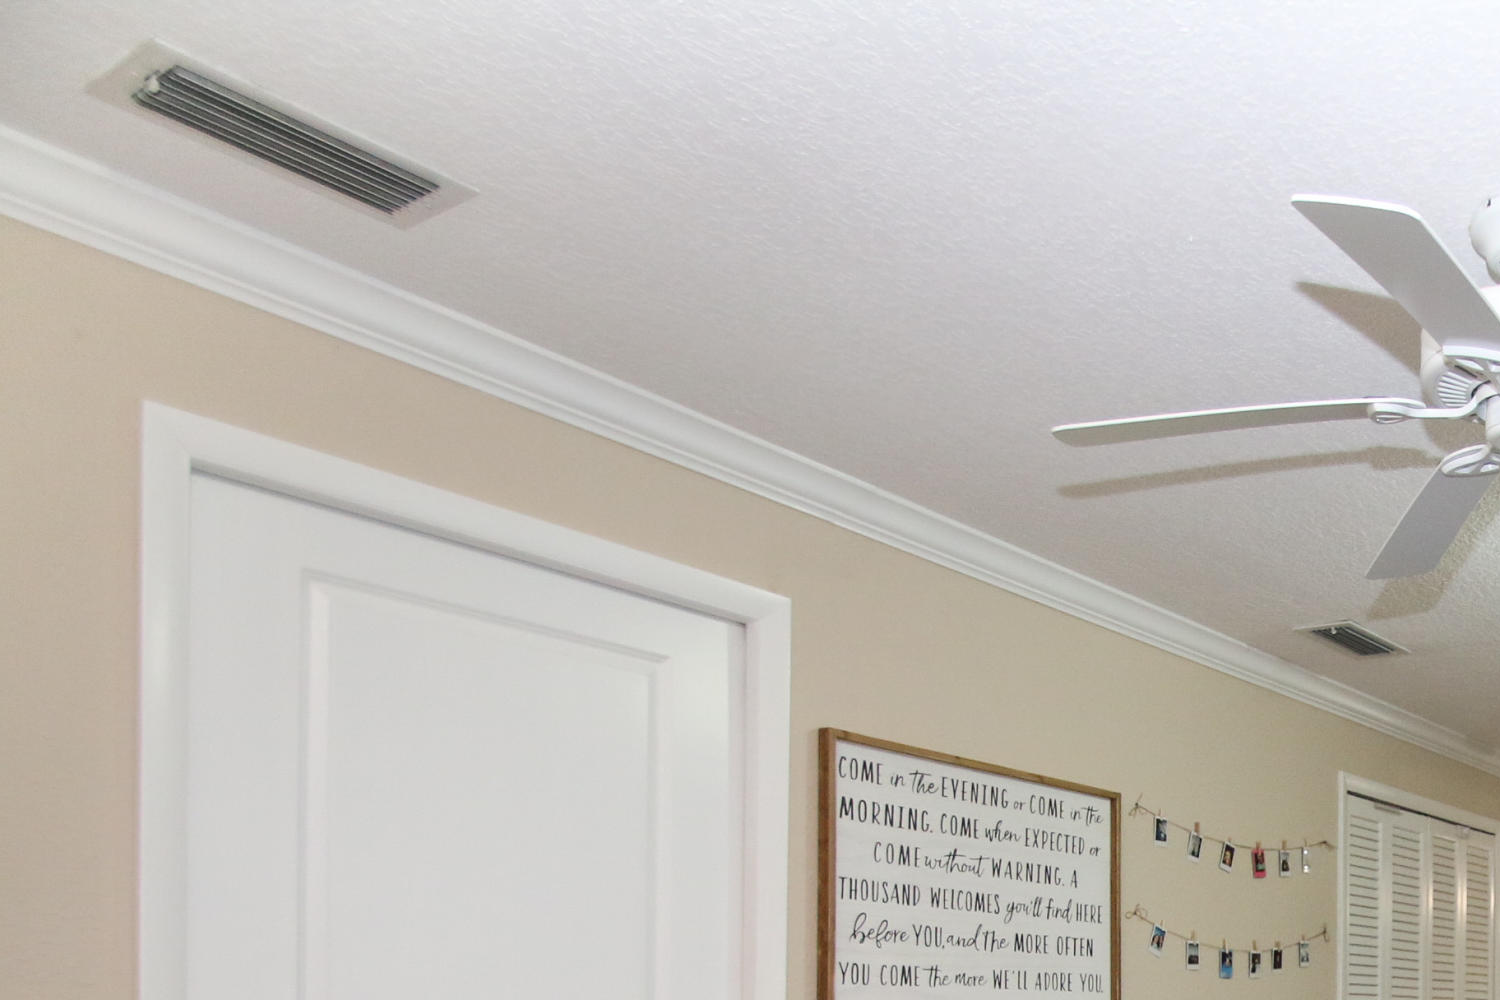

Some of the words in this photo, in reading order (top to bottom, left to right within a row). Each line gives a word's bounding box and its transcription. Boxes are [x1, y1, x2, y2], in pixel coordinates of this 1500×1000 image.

[838, 756, 884, 785] COME
[890, 774, 906, 787] in
[909, 770, 940, 794] the
[941, 776, 1009, 809] EVENING
[1013, 800, 1026, 810] or
[1029, 794, 1065, 819] COME
[1070, 808, 1081, 821] in
[1081, 806, 1104, 826] the
[940, 813, 979, 839] COME
[984, 820, 1021, 842] when
[1024, 827, 1085, 855] EXPECTED
[1089, 846, 1101, 856] or
[873, 841, 921, 868] COME
[924, 848, 990, 878] without
[1070, 869, 1078, 888] A
[838, 876, 921, 906] THOUSAND
[930, 887, 1000, 914] WELCOMES
[1045, 898, 1073, 924] find
[1075, 902, 1103, 924] HERE
[848, 912, 910, 949] before
[946, 923, 983, 952] and
[982, 930, 1010, 953] the
[1013, 932, 1049, 954] MORE
[1056, 936, 1094, 957] OFTEN
[838, 961, 870, 986] YOU
[880, 964, 921, 987] COME
[922, 965, 952, 988] the
[954, 972, 988, 987] more
[1034, 972, 1073, 992] ADORE
